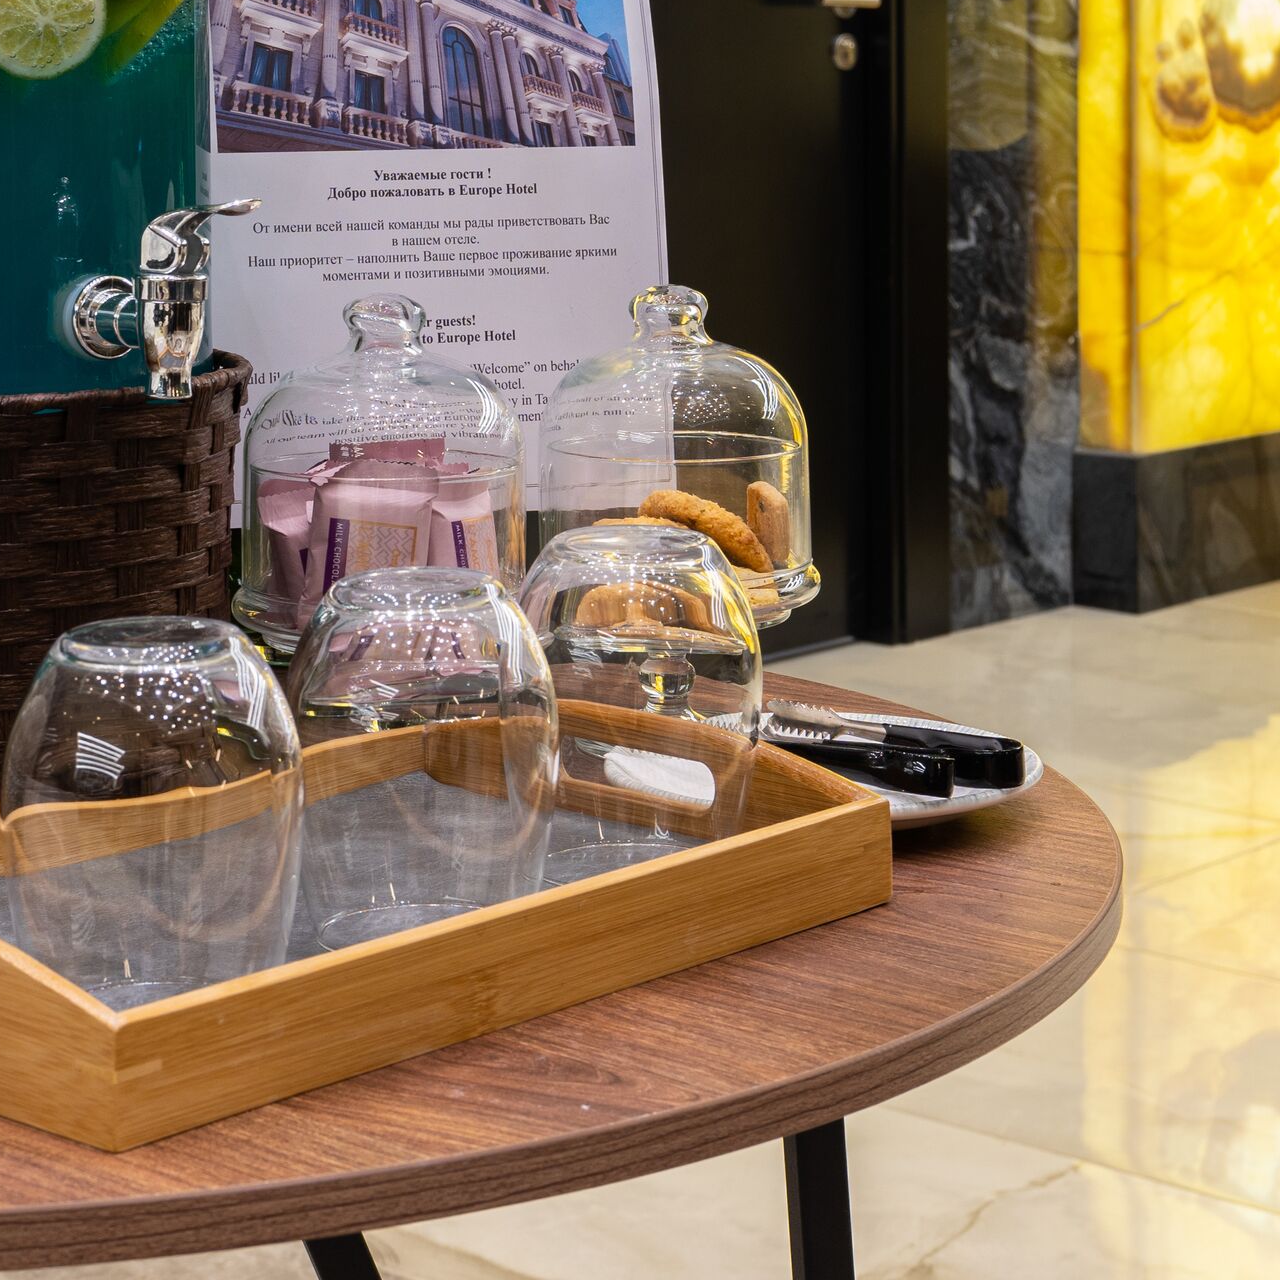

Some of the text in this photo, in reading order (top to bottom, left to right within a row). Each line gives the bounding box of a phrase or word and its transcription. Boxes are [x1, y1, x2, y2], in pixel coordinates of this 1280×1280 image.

[373, 169, 447, 182] Уважаемые
[450, 171, 484, 180] гости
[327, 183, 538, 201] Добро пожаловать в Europe Hotel
[252, 213, 610, 234] От имени всей нашей команды мы рады приветствовать Вас
[392, 235, 480, 246] в нашем отеле.
[248, 255, 276, 267] Наш
[280, 255, 343, 269] приоритет
[357, 253, 420, 264] наполнить
[423, 250, 455, 262] Ваше
[459, 250, 499, 263] первое
[502, 248, 572, 262] проживание
[575, 247, 617, 260] яркими
[322, 266, 550, 282] моментами и позитивными эмоциями.
[435, 315, 476, 330] guests!
[422, 330, 516, 345] to Europe Hotel
[533, 364, 548, 373] on
[522, 395, 532, 405] in
[335, 522, 344, 544] MILK
